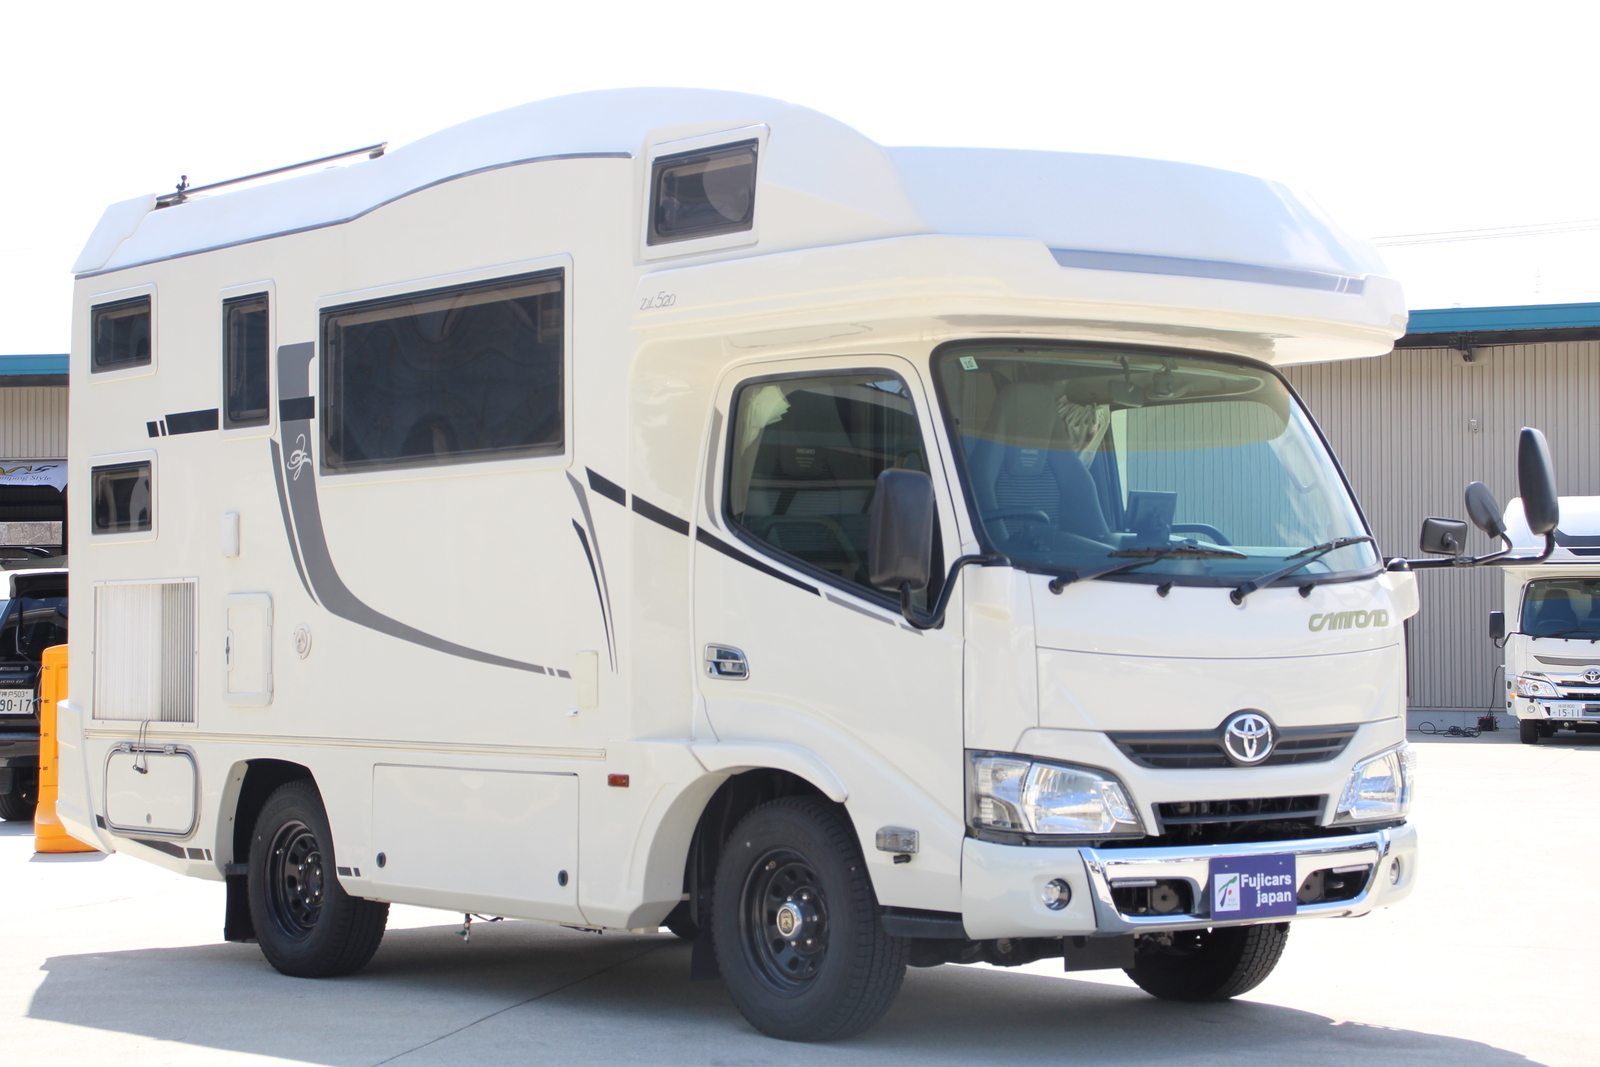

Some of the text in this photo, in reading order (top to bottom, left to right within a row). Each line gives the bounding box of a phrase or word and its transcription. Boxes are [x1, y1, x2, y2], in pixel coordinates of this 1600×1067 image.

[655, 290, 677, 308] 520
[1558, 708, 1580, 717] 15-11
[1240, 872, 1292, 891] Fujicars
[1255, 889, 1292, 908] japan
